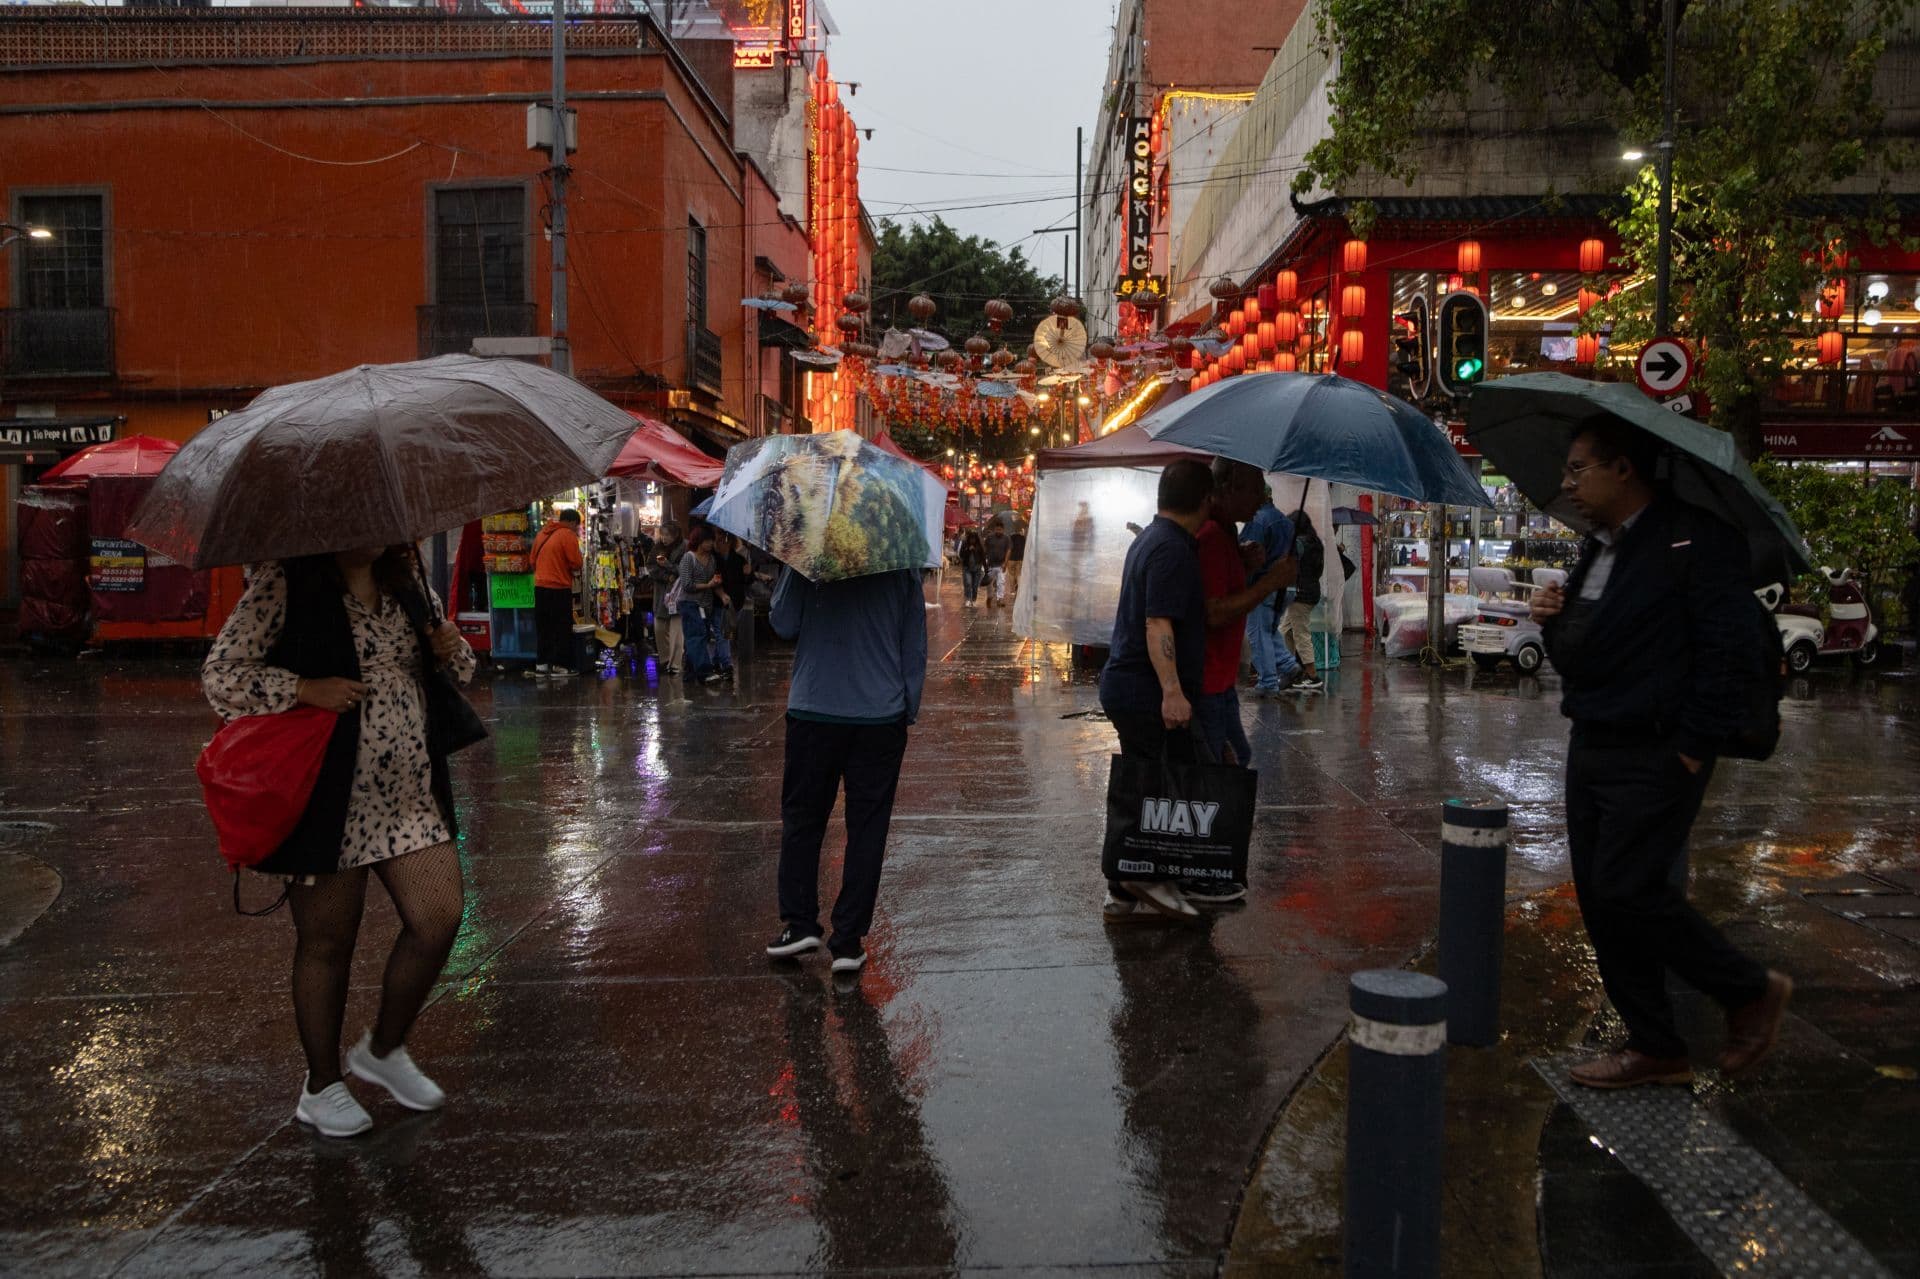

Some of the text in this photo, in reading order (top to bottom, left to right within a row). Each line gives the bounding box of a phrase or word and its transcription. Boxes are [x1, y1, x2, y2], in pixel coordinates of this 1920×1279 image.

[1132, 122, 1151, 270] HONG KING
[44, 429, 60, 441] Pepe
[1764, 435, 1798, 446] HINA
[1140, 797, 1219, 838] MAY
[1168, 865, 1181, 875] 55
